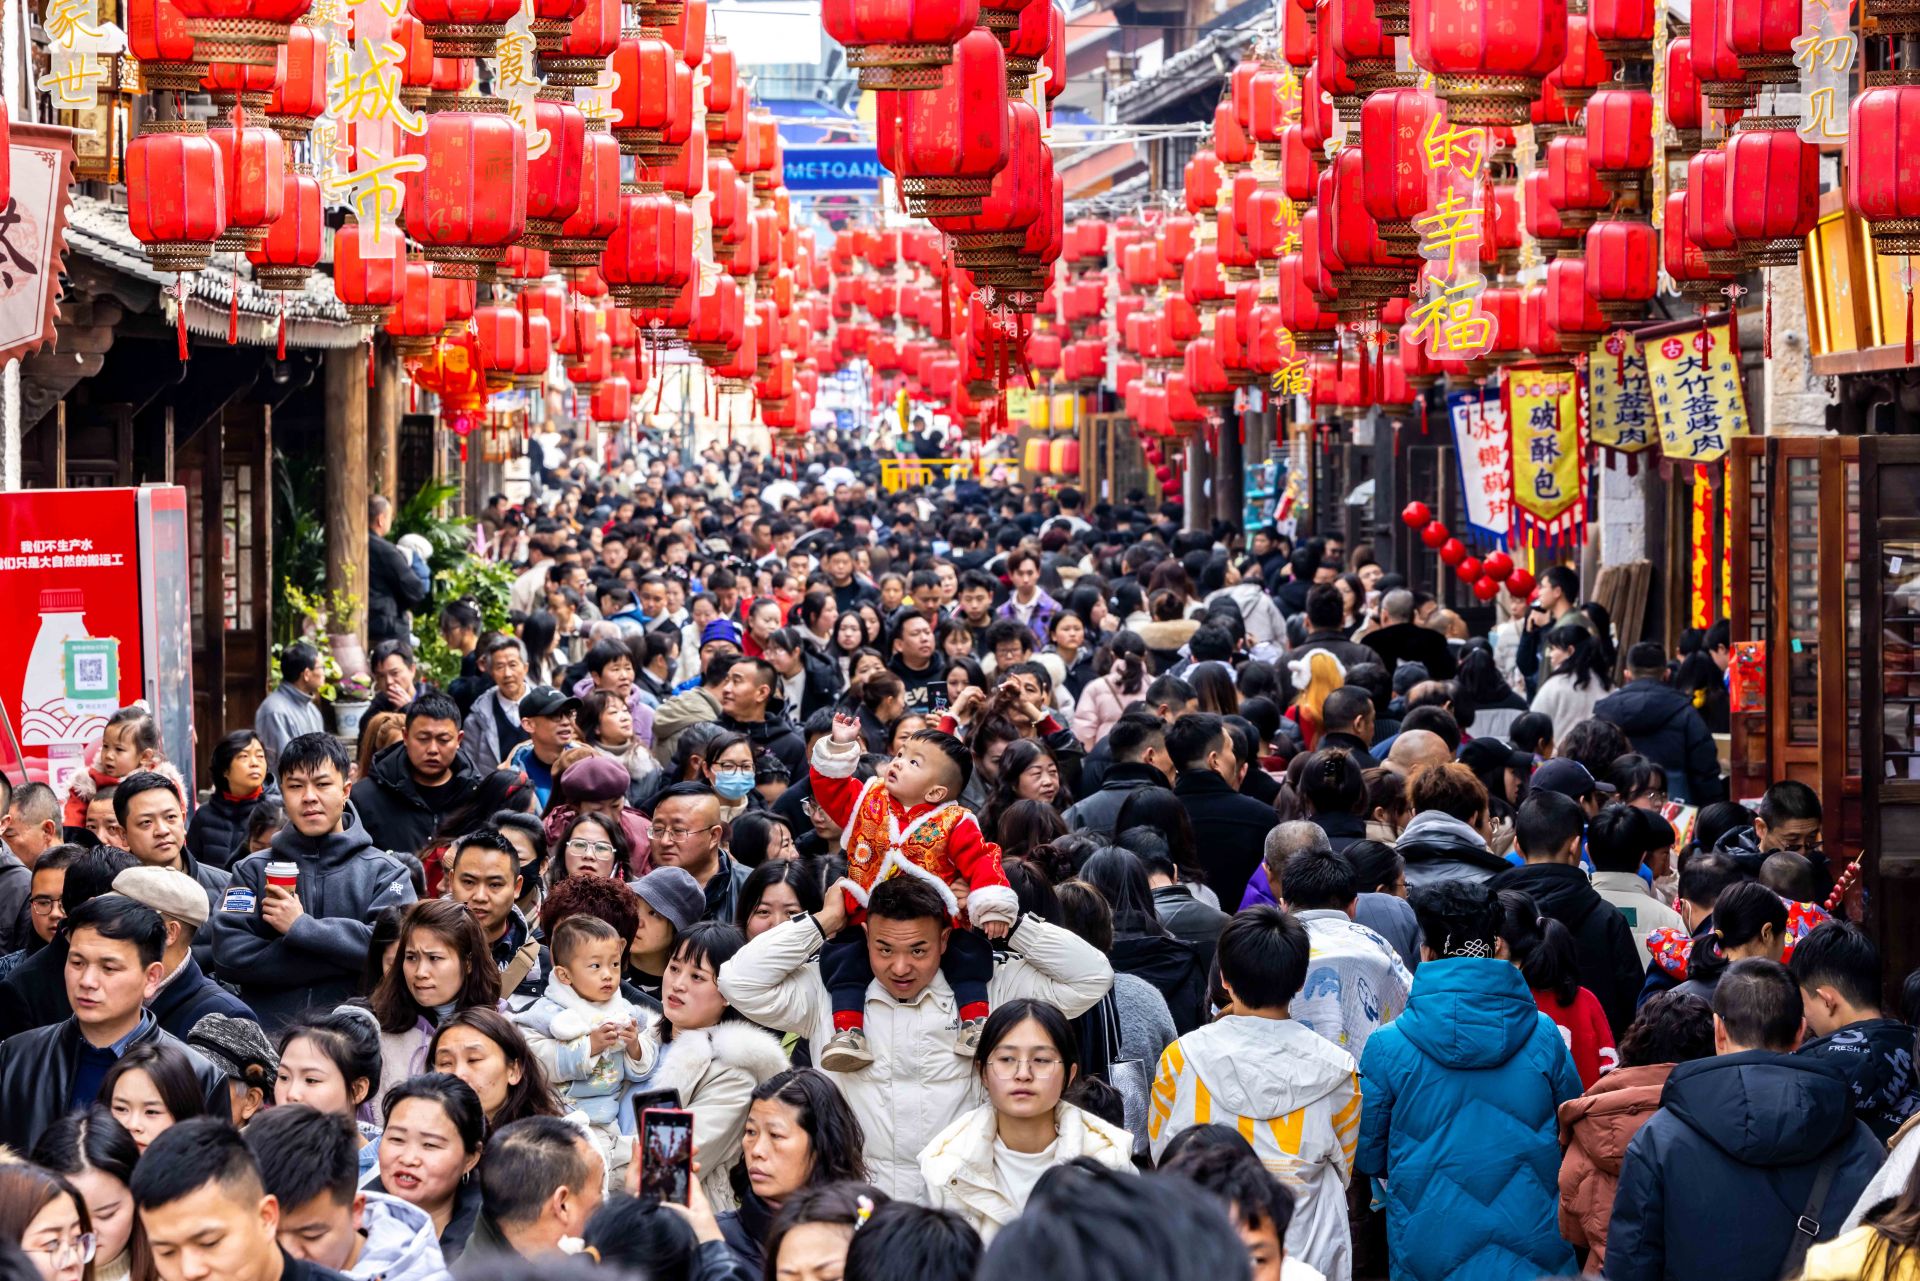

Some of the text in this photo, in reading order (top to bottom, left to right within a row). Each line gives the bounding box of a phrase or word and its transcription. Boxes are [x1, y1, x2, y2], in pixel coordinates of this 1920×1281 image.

[1796, 0, 1850, 137] 初见
[332, 0, 421, 243] 城市
[785, 161, 890, 179] METOAN
[1411, 72, 1486, 352] 的幸福
[1529, 400, 1562, 499] 破酥包
[20, 538, 93, 553] 我们不生产水
[1828, 1044, 1861, 1053] FRESH
